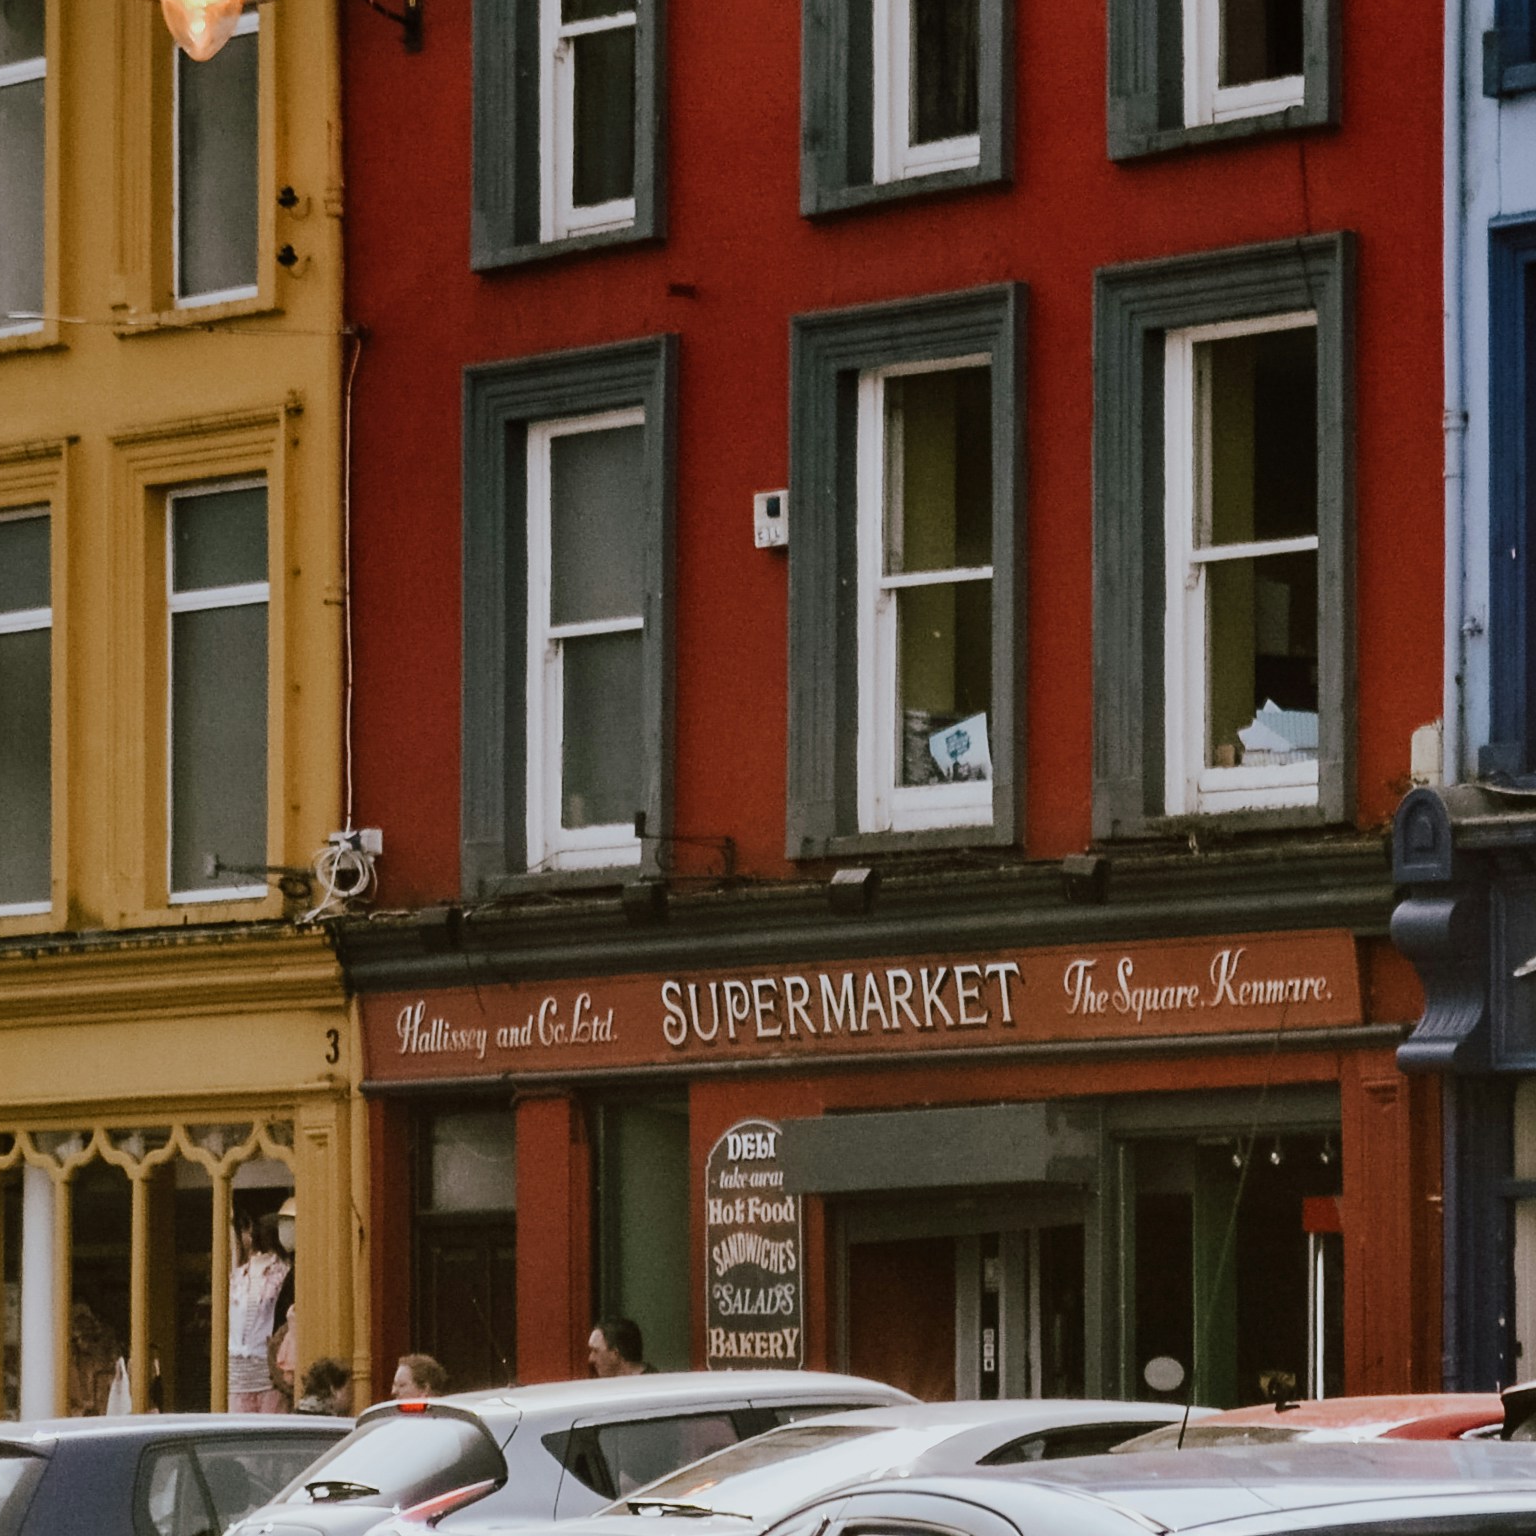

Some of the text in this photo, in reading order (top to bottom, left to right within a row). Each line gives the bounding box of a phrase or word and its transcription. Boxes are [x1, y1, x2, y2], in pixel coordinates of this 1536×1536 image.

[1063, 958, 1109, 1015] The
[1209, 947, 1333, 1007] Kenmare.
[661, 960, 1023, 1047] SUPERMARKET
[325, 1027, 340, 1065] 3
[395, 999, 487, 1060] Hallissey
[495, 1014, 534, 1049] and
[726, 1132, 776, 1161] DELI
[708, 1195, 796, 1225] Hot Food
[712, 1232, 797, 1277] SANDWICHES
[713, 1282, 796, 1316] SALADS
[709, 1327, 801, 1359] BAKERY
